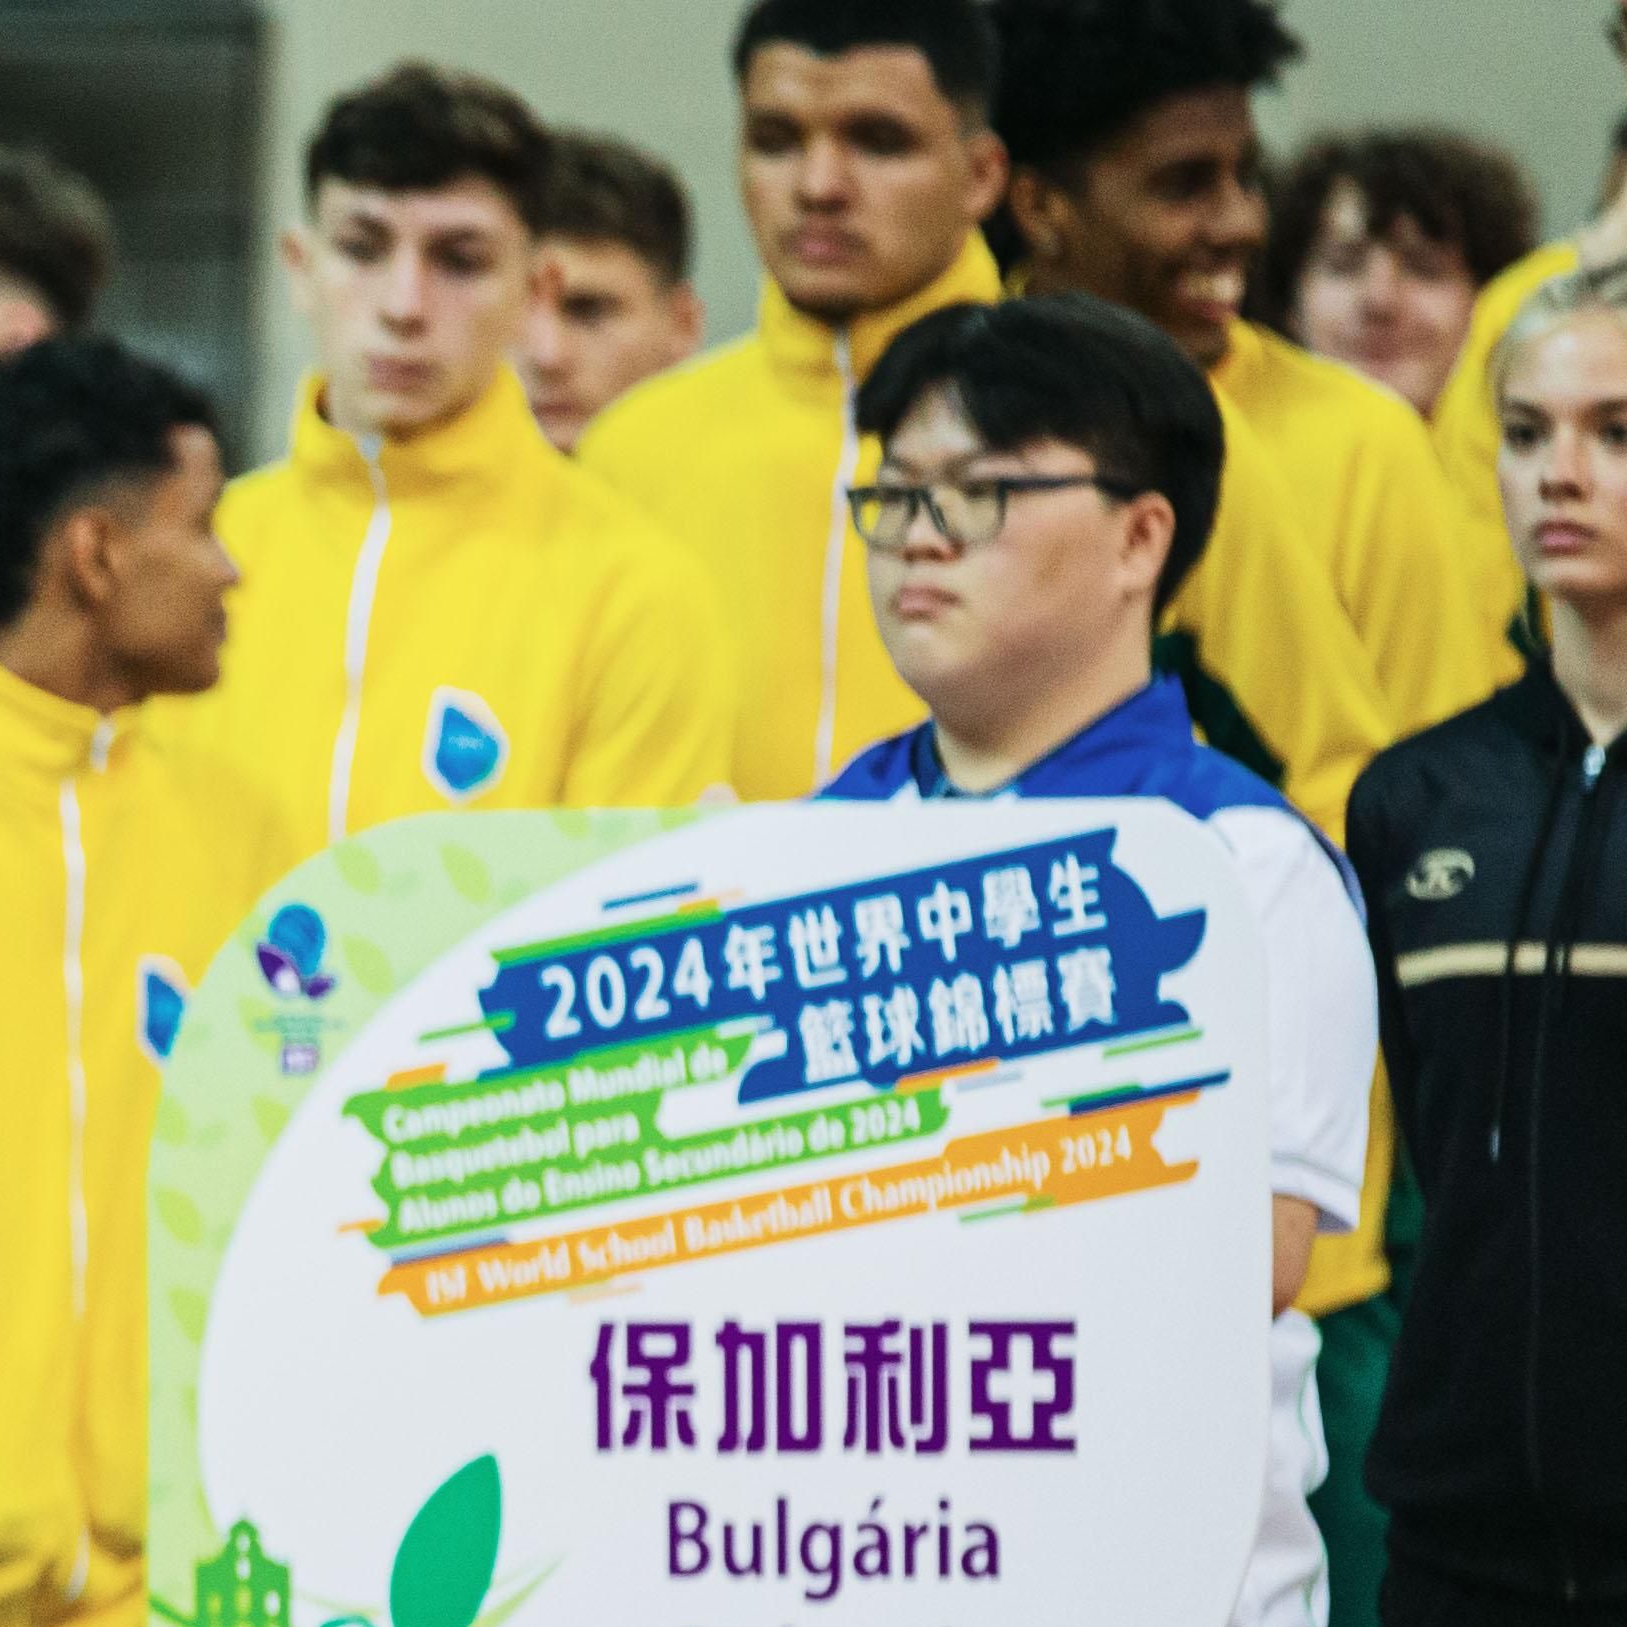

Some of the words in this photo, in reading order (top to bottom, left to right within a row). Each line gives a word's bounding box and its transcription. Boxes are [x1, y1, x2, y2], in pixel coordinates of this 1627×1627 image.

[1058, 1124, 1133, 1175] 2024
[589, 1319, 1077, 1454] 保加利亞
[667, 1496, 1001, 1601] Bulgária
